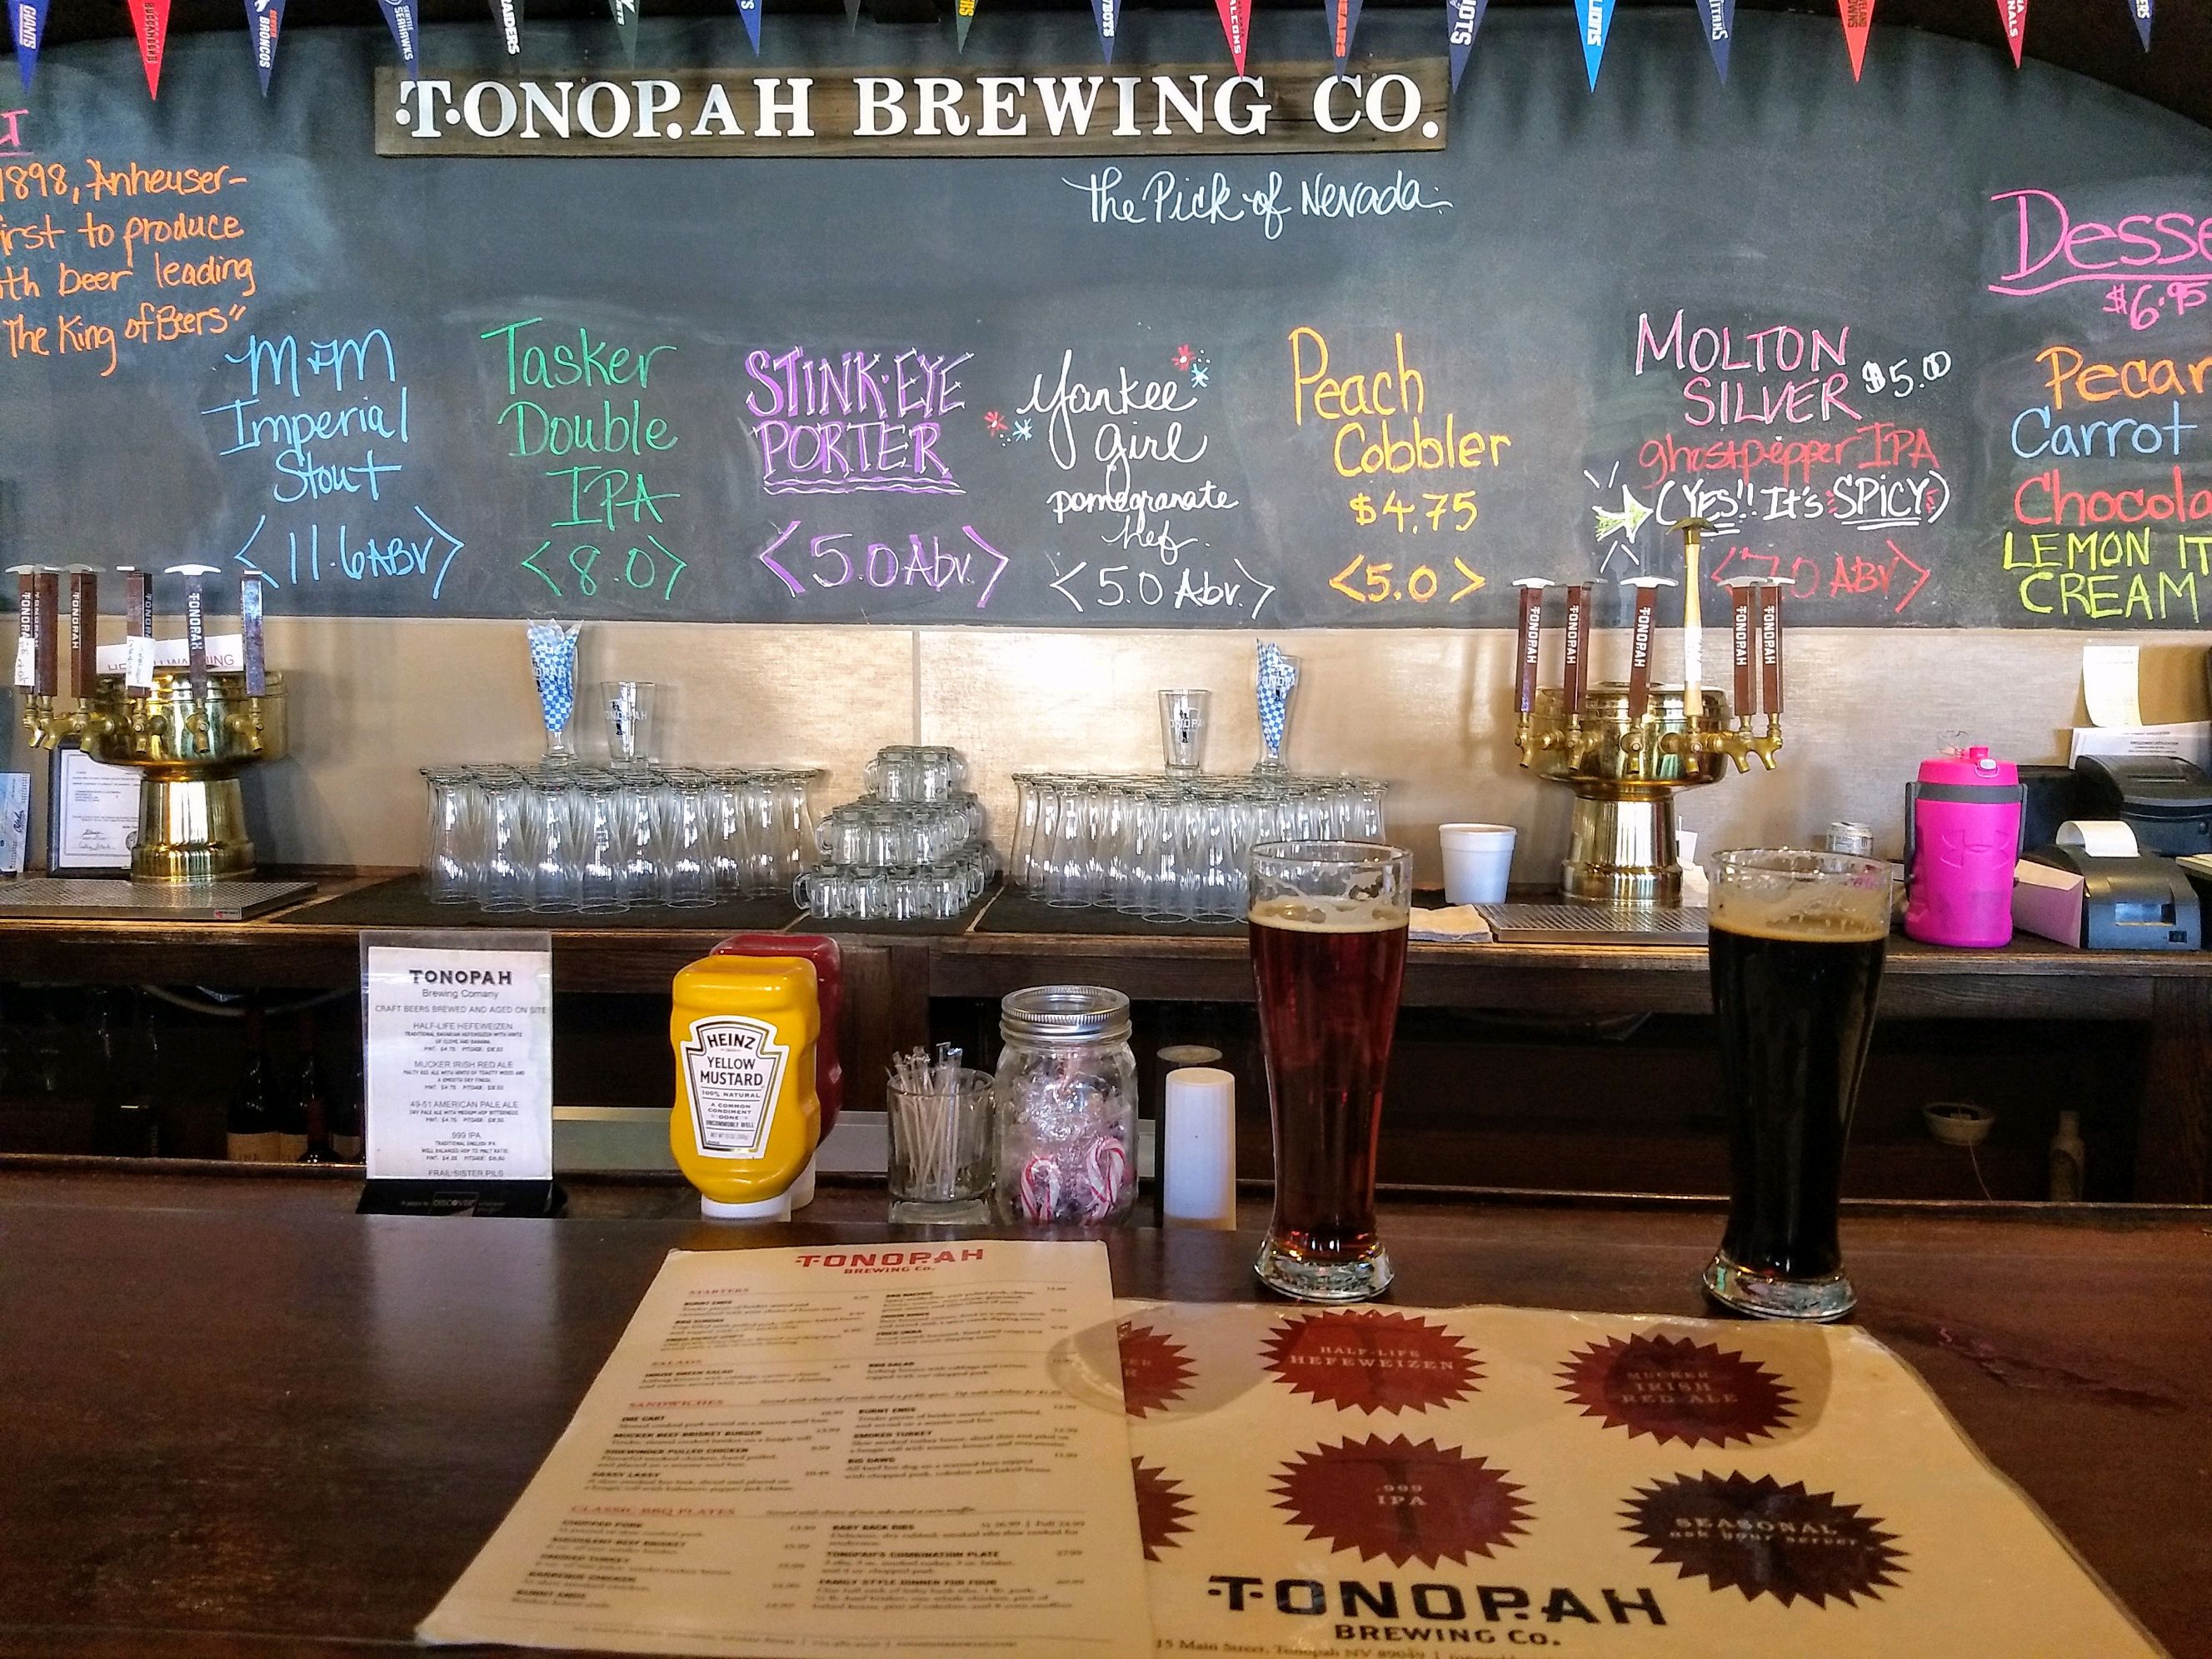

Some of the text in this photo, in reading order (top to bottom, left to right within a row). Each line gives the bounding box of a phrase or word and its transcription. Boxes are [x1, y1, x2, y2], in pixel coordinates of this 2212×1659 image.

[22, 4, 37, 50] GIANTS
[259, 15, 271, 68] BRONCOS
[394, 6, 414, 61] SEAHAWKS
[852, 74, 1273, 137] BREWING
[1312, 73, 1440, 139] CO.
[1141, 170, 1245, 225] Pick
[1241, 170, 1292, 240] of
[1301, 170, 1454, 218] Nevada
[83, 212, 114, 248] to
[123, 211, 245, 267] produce
[154, 252, 257, 297] leading
[59, 314, 117, 377] King
[124, 305, 157, 342] of
[481, 317, 678, 396] Tasker
[1635, 308, 1850, 376] MOLTON
[1287, 326, 1425, 427] Peach
[1682, 372, 1864, 427] SILVER
[201, 386, 409, 465] Imperial
[497, 399, 679, 457] Double
[1016, 347, 1198, 470] Yankee
[2010, 399, 2199, 460] Carrot
[751, 418, 953, 480] PORTER
[1332, 414, 1511, 478] Cobbler
[1856, 421, 1942, 470] IPA
[274, 448, 403, 503] Stout
[545, 465, 681, 532] IPA
[1046, 479, 1240, 534] pomegranate
[1349, 490, 1478, 535] $4.75
[1762, 485, 1825, 522] It's
[2002, 527, 2151, 572] LEMON
[2019, 570, 2200, 624] CREAM
[1526, 606, 1540, 665] TONOPAH
[1566, 604, 1580, 665] TONOPAH
[1634, 606, 1651, 667] TONOPAH
[1735, 605, 1748, 667] TONOPAH
[1762, 605, 1775, 666] TONOPAH
[409, 969, 513, 985] TONOPAH
[422, 989, 458, 999] Brewing
[403, 1005, 430, 1013] BEERS
[514, 1006, 528, 1014] ON
[707, 1032, 756, 1050] HEINZ
[707, 1056, 756, 1070] YELLOW
[700, 1070, 764, 1087] MUSTARD
[796, 1248, 985, 1268] TONOPAH
[843, 1266, 911, 1275] BREWING
[1290, 1355, 1455, 1371] HEFEWEIZEN
[1376, 1494, 1427, 1507] IPA
[1675, 1517, 1838, 1536] SEASONAL
[1207, 1575, 1668, 1626] TONOPAH
[1334, 1623, 1496, 1645] BREWING
